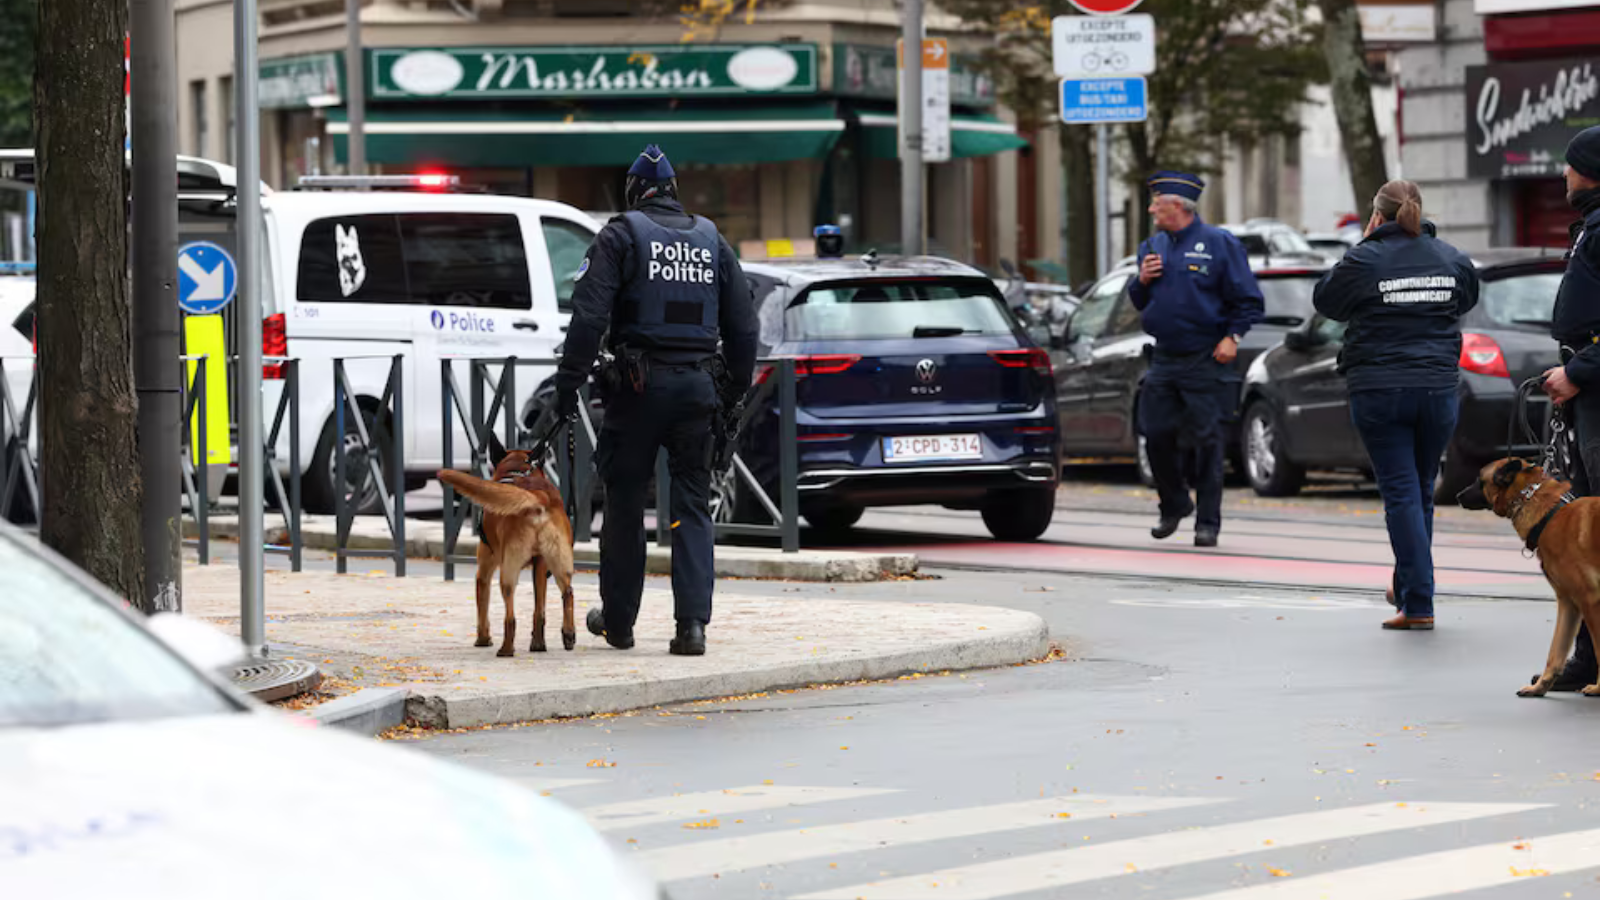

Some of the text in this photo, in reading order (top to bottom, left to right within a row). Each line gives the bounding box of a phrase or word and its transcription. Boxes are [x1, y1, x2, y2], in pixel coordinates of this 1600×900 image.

[651, 241, 712, 263] Police
[648, 261, 714, 284] Politie
[450, 313, 494, 332] Police
[911, 386, 942, 394] GOLF
